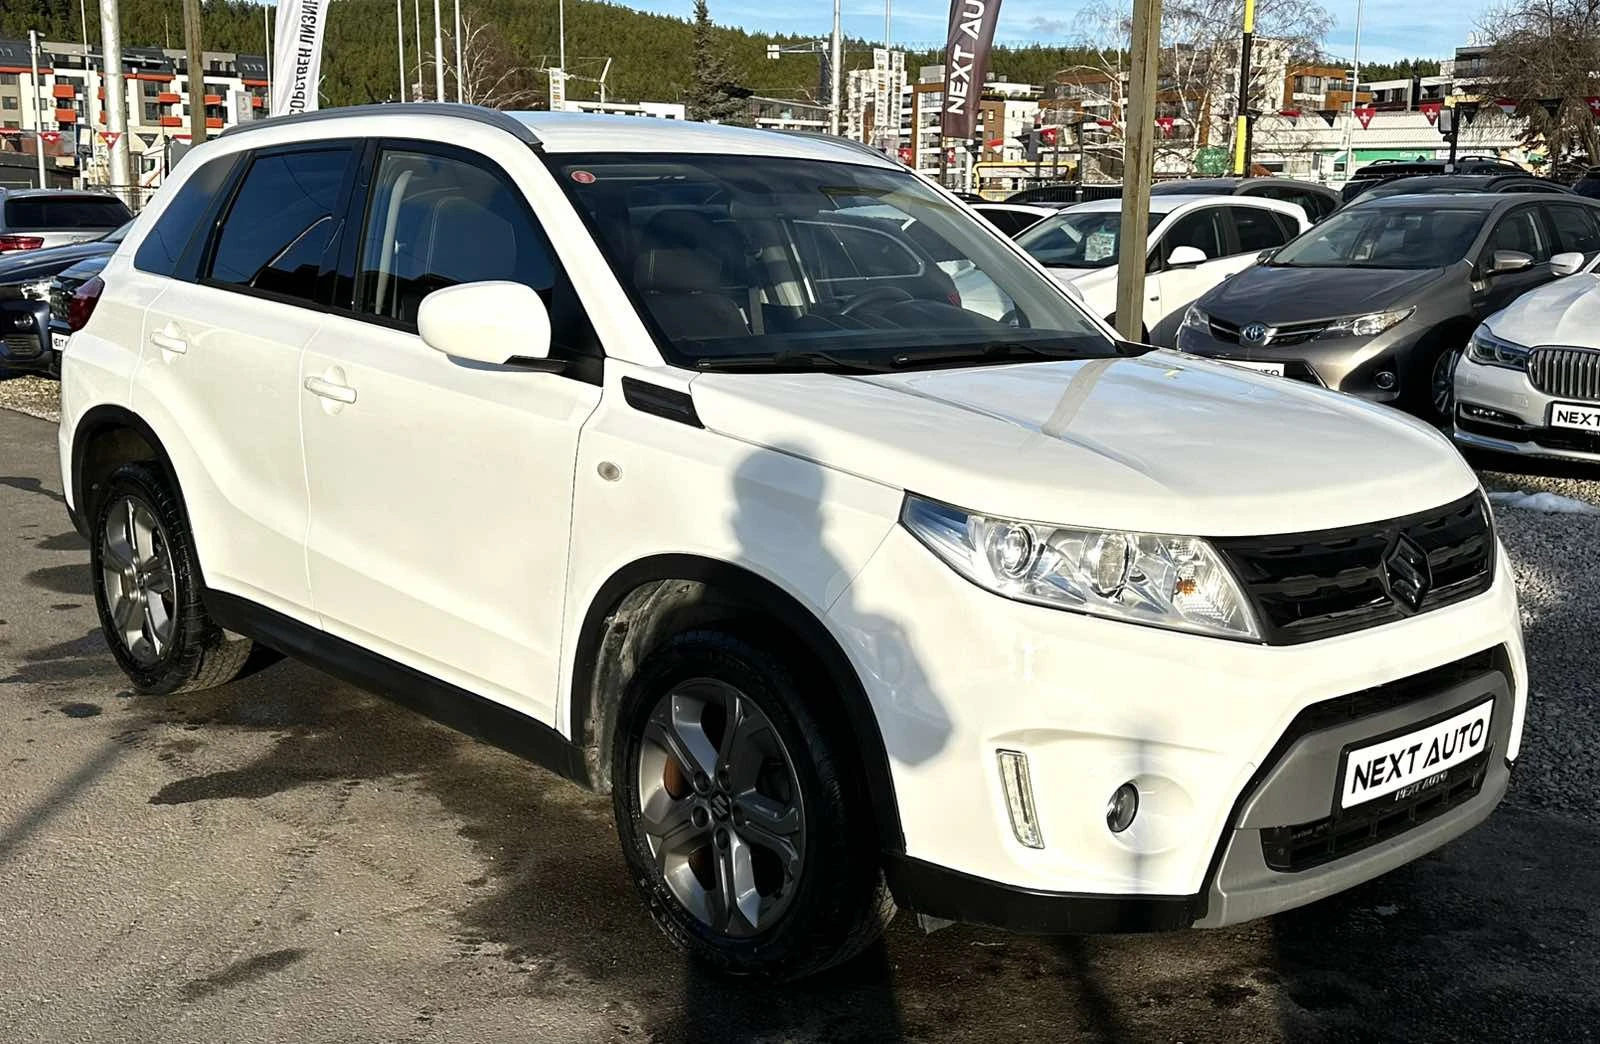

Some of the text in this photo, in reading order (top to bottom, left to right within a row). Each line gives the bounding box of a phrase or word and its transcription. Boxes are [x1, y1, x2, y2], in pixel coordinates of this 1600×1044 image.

[947, 43, 975, 115] NEXT
[1557, 409, 1600, 427] NEXT
[1352, 718, 1484, 794] NEXT AUTO
